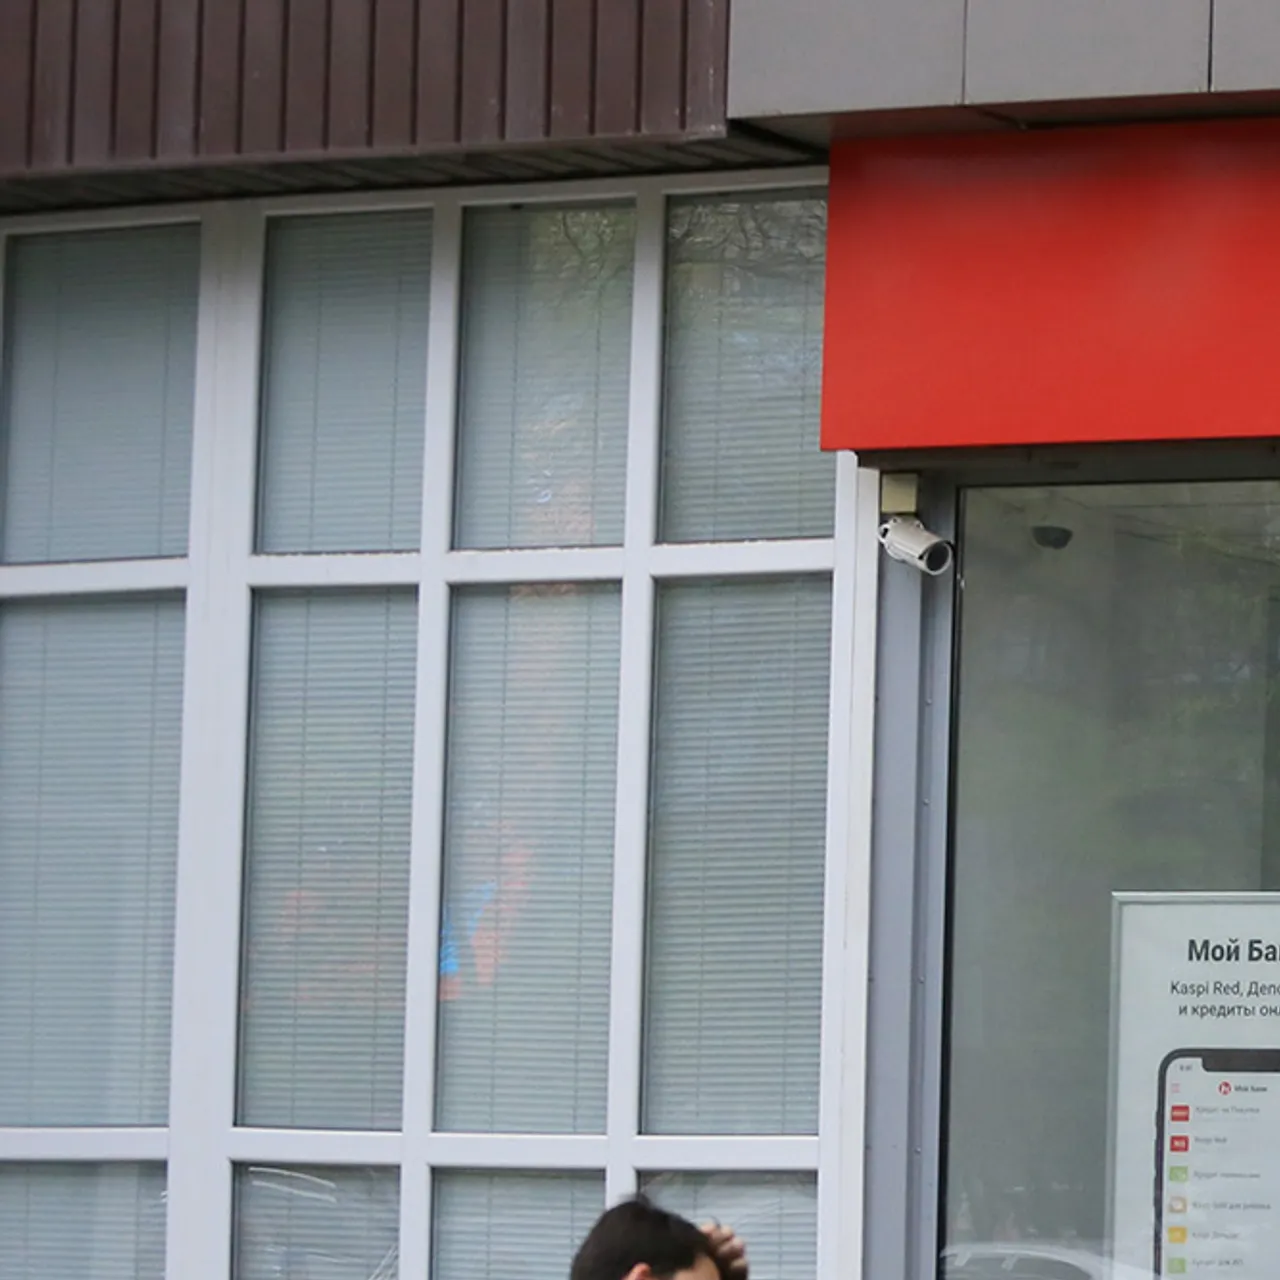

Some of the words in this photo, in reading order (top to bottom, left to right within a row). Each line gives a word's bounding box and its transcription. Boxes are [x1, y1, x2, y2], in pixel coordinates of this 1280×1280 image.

[1187, 937, 1240, 962] Мой
[1170, 981, 1209, 998] Kaspi
[1213, 981, 1244, 997] Red,
[1178, 1005, 1187, 1016] и
[1190, 1005, 1255, 1019] кредиты
